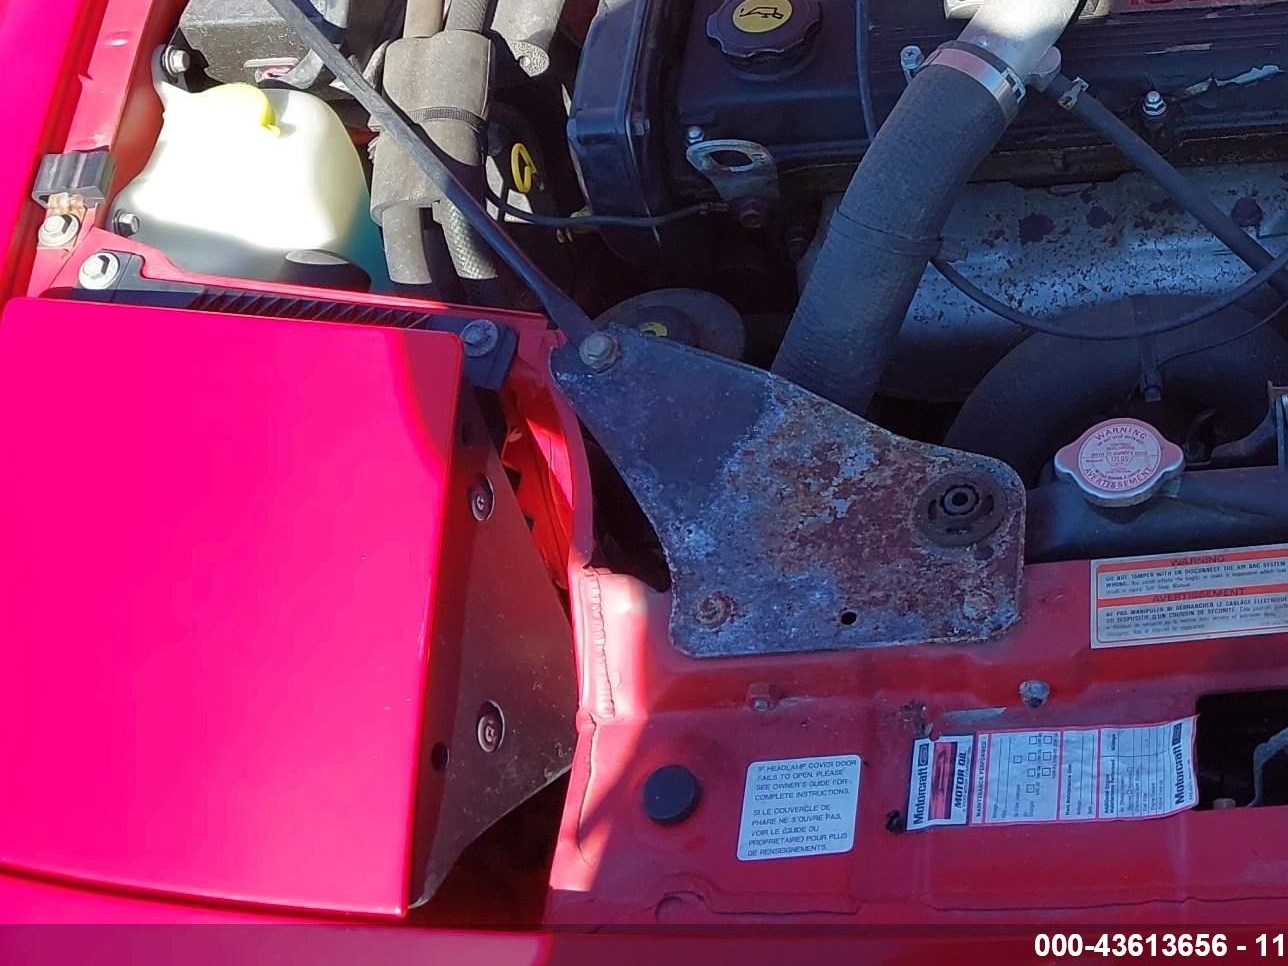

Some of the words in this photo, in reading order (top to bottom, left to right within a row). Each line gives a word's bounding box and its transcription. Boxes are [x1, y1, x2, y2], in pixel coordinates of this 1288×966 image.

[1095, 426, 1148, 440] WARNING
[1084, 467, 1152, 489] AVERTISSEMENT
[1168, 554, 1226, 567] WARNING
[1152, 587, 1246, 603] AVERTISSEMENT
[766, 763, 807, 772] HEADLAMP
[808, 761, 834, 769] COVER
[835, 759, 857, 767] DOOR
[958, 750, 967, 768] OIL
[757, 773, 778, 781] FAILS
[815, 769, 844, 778] PLEASE
[1172, 745, 1186, 806] Motorcraft
[756, 783, 770, 791] SEE
[772, 780, 807, 790] OWNER'S
[808, 779, 830, 787] GUIDE
[953, 768, 965, 809] MOTOR
[754, 792, 794, 801] COMPLETE
[912, 766, 929, 825] Motorcraft
[773, 804, 818, 815] COUVERCLE
[820, 803, 831, 811] DE
[751, 817, 777, 826] PHARE
[778, 816, 789, 824] NE
[791, 813, 824, 823] S'OUVRE
[751, 828, 769, 837] VOIR
[770, 827, 780, 835] LE
[808, 824, 820, 832] DU
[805, 834, 827, 842] POUR
[828, 832, 848, 840] PLUS
[747, 849, 758, 857] DE
